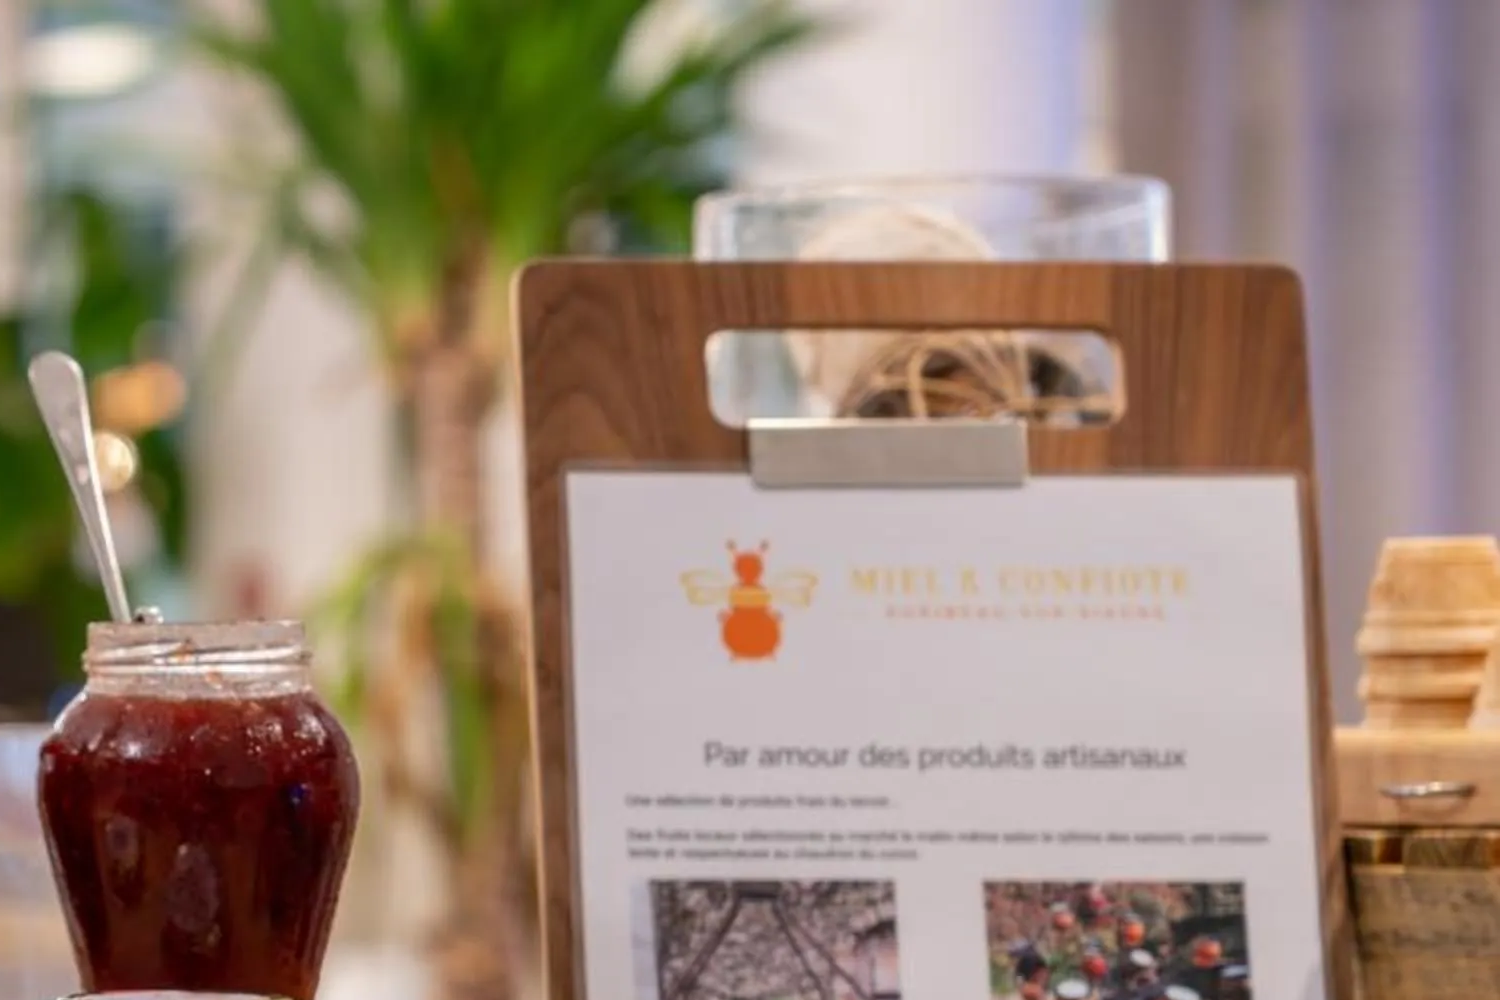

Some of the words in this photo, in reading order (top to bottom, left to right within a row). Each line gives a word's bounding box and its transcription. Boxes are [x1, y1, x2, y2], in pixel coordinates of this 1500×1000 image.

[851, 564, 941, 596] MIEL
[703, 740, 748, 768] Par
[758, 746, 850, 770] amour
[858, 742, 910, 770] des
[918, 743, 1034, 775] produits
[1042, 744, 1188, 770] artisanaux
